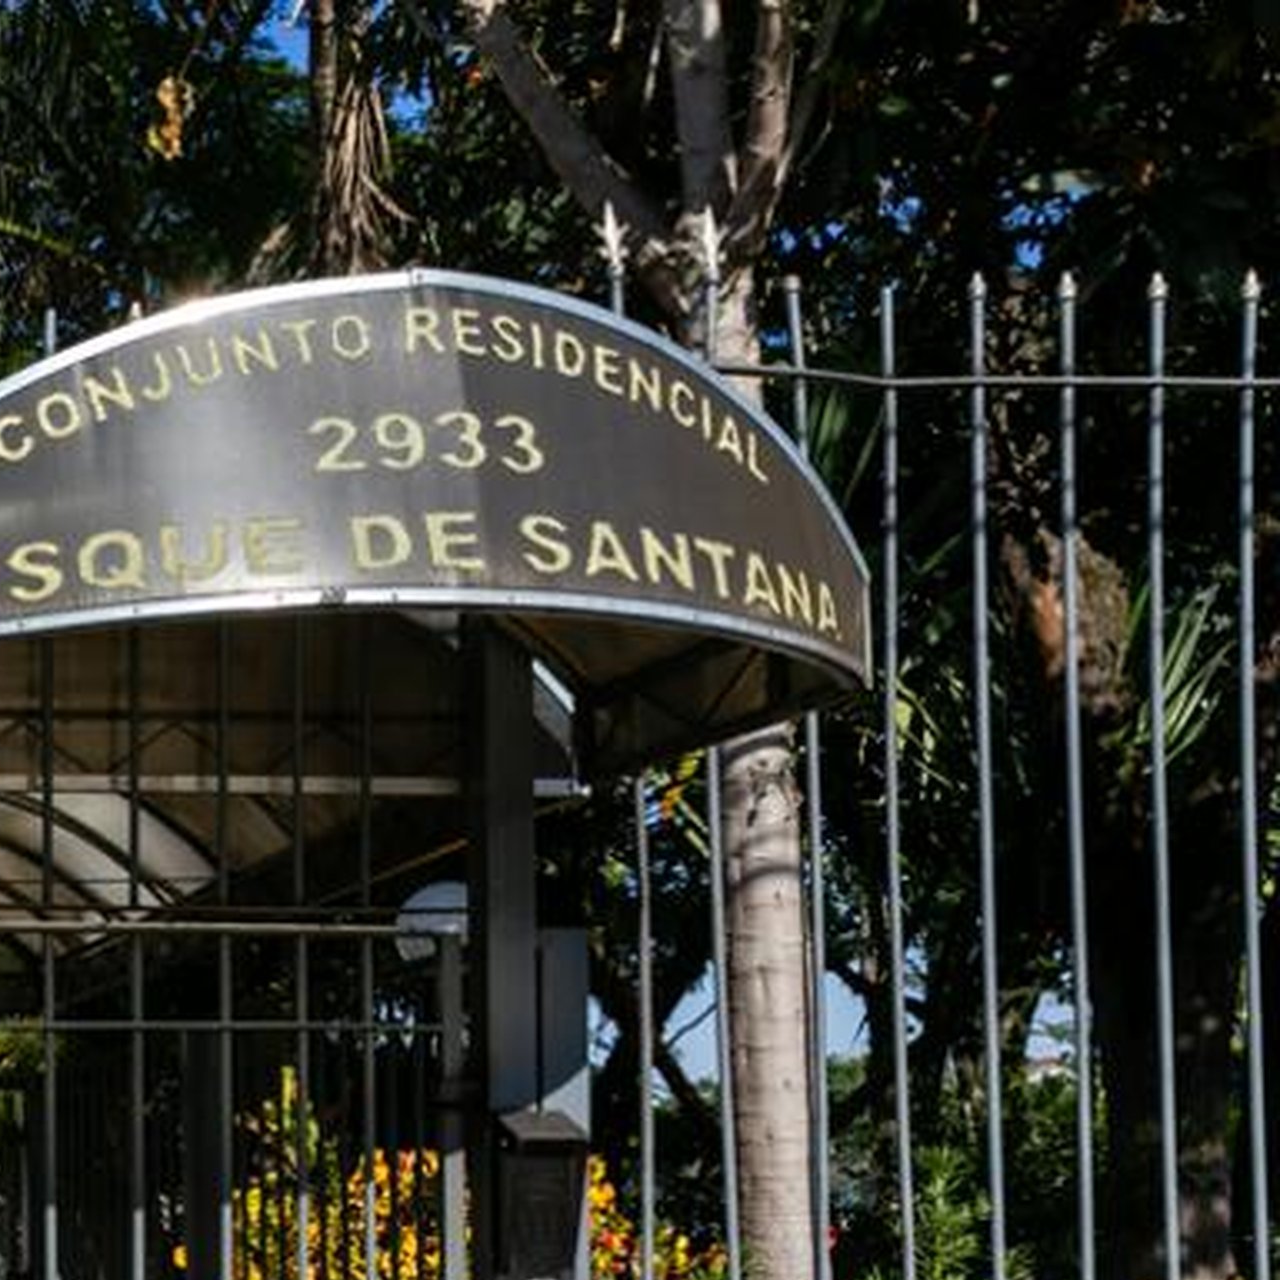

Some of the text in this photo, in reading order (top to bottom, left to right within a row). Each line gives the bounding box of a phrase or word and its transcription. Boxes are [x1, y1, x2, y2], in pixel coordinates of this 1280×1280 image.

[308, 413, 546, 473] 2933
[406, 307, 767, 483] RESIDENCIAL
[354, 512, 485, 572] DE
[522, 514, 840, 634] SANTANA
